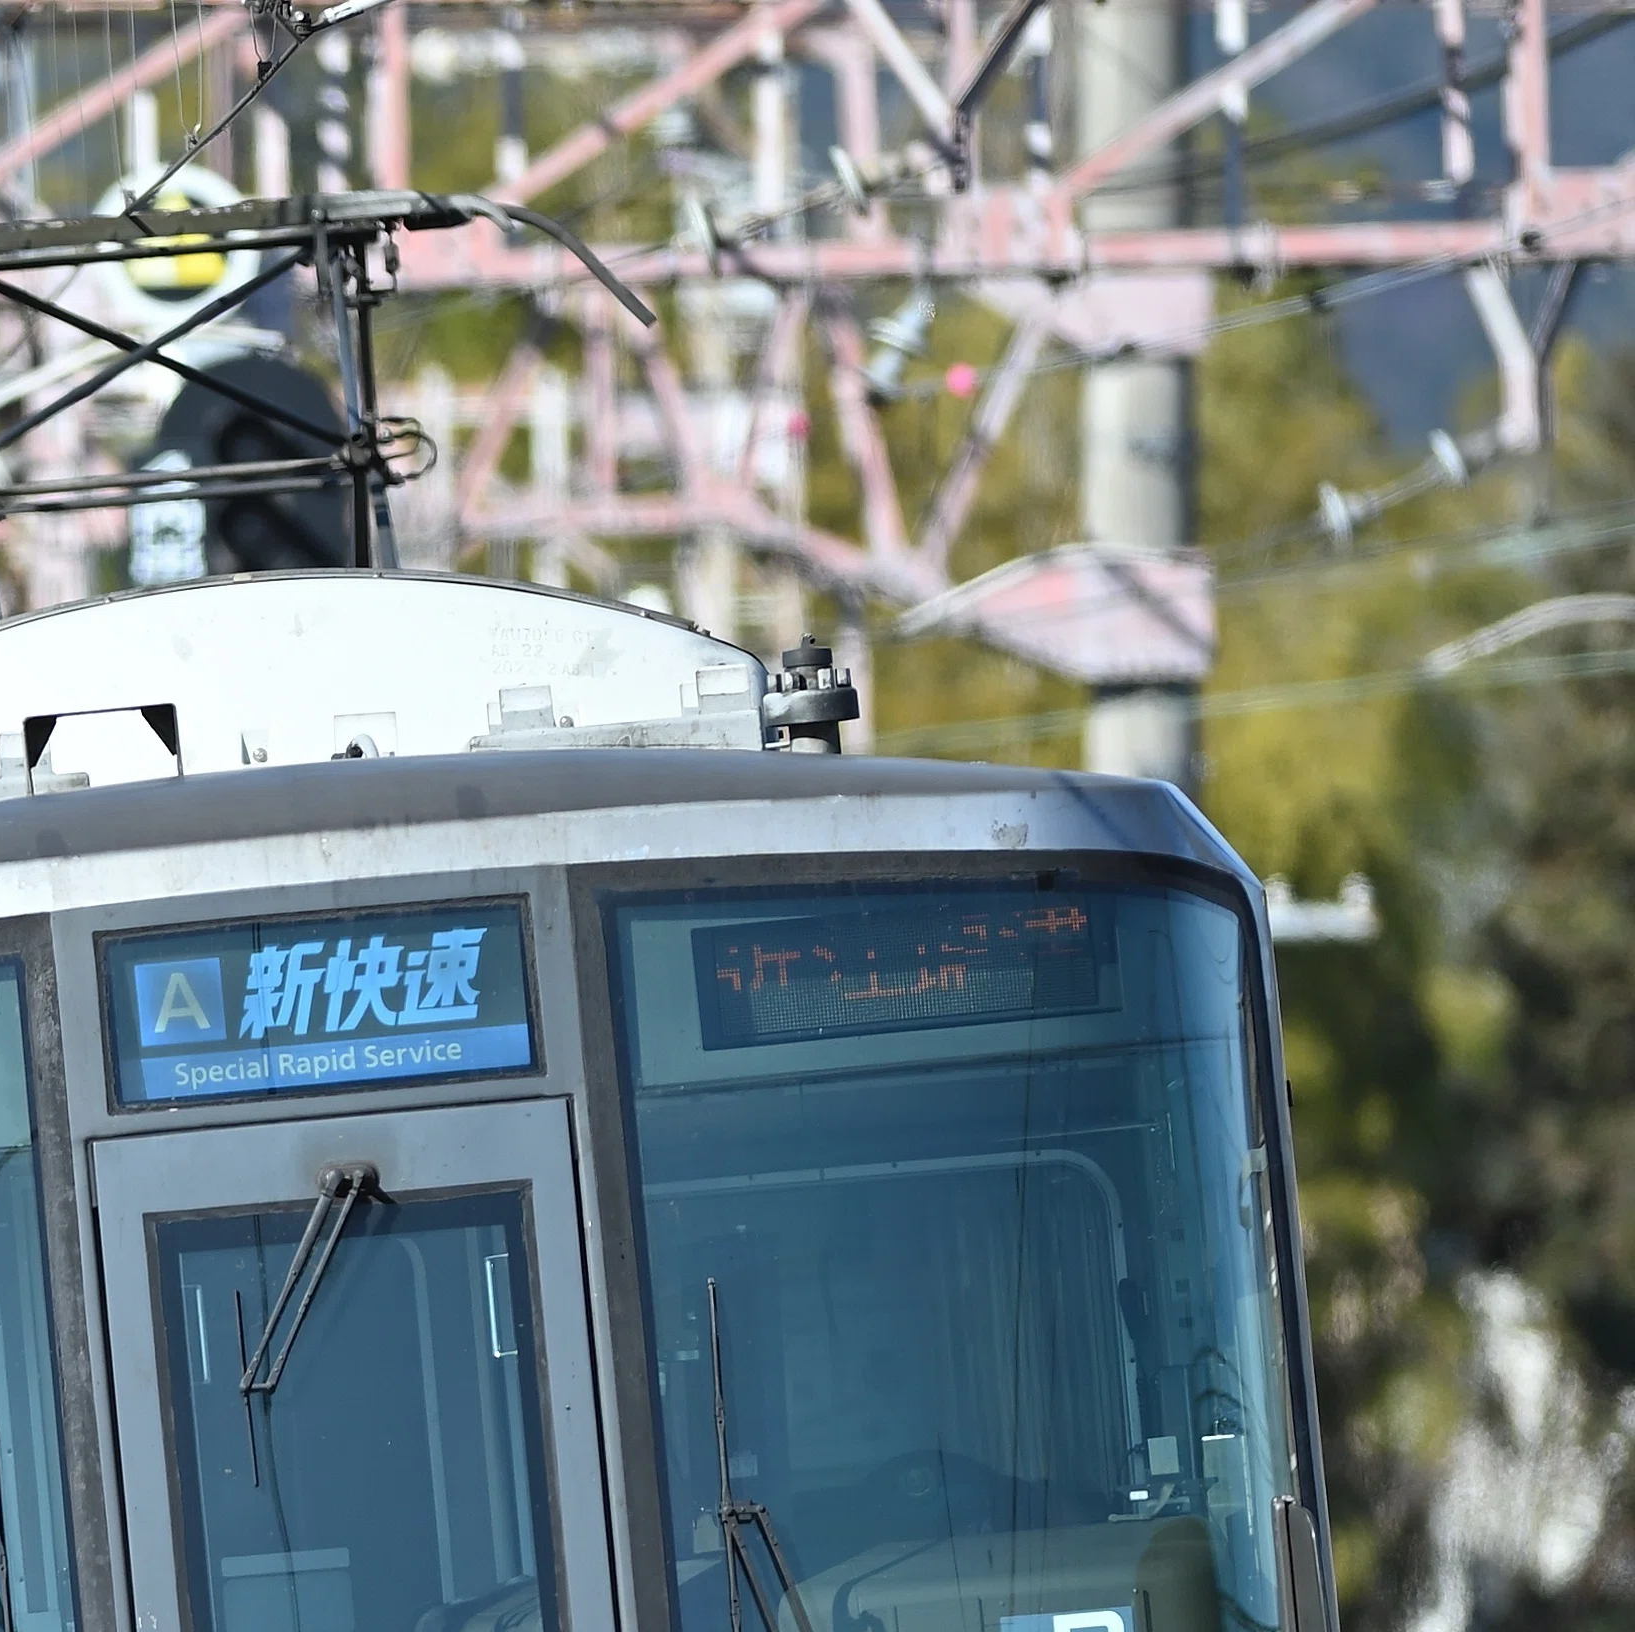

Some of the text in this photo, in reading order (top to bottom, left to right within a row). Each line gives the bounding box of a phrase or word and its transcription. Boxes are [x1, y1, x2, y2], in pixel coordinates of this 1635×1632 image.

[154, 972, 211, 1033] A
[238, 927, 488, 1040] 新快速
[175, 1039, 463, 1090] Special Rapid Service
